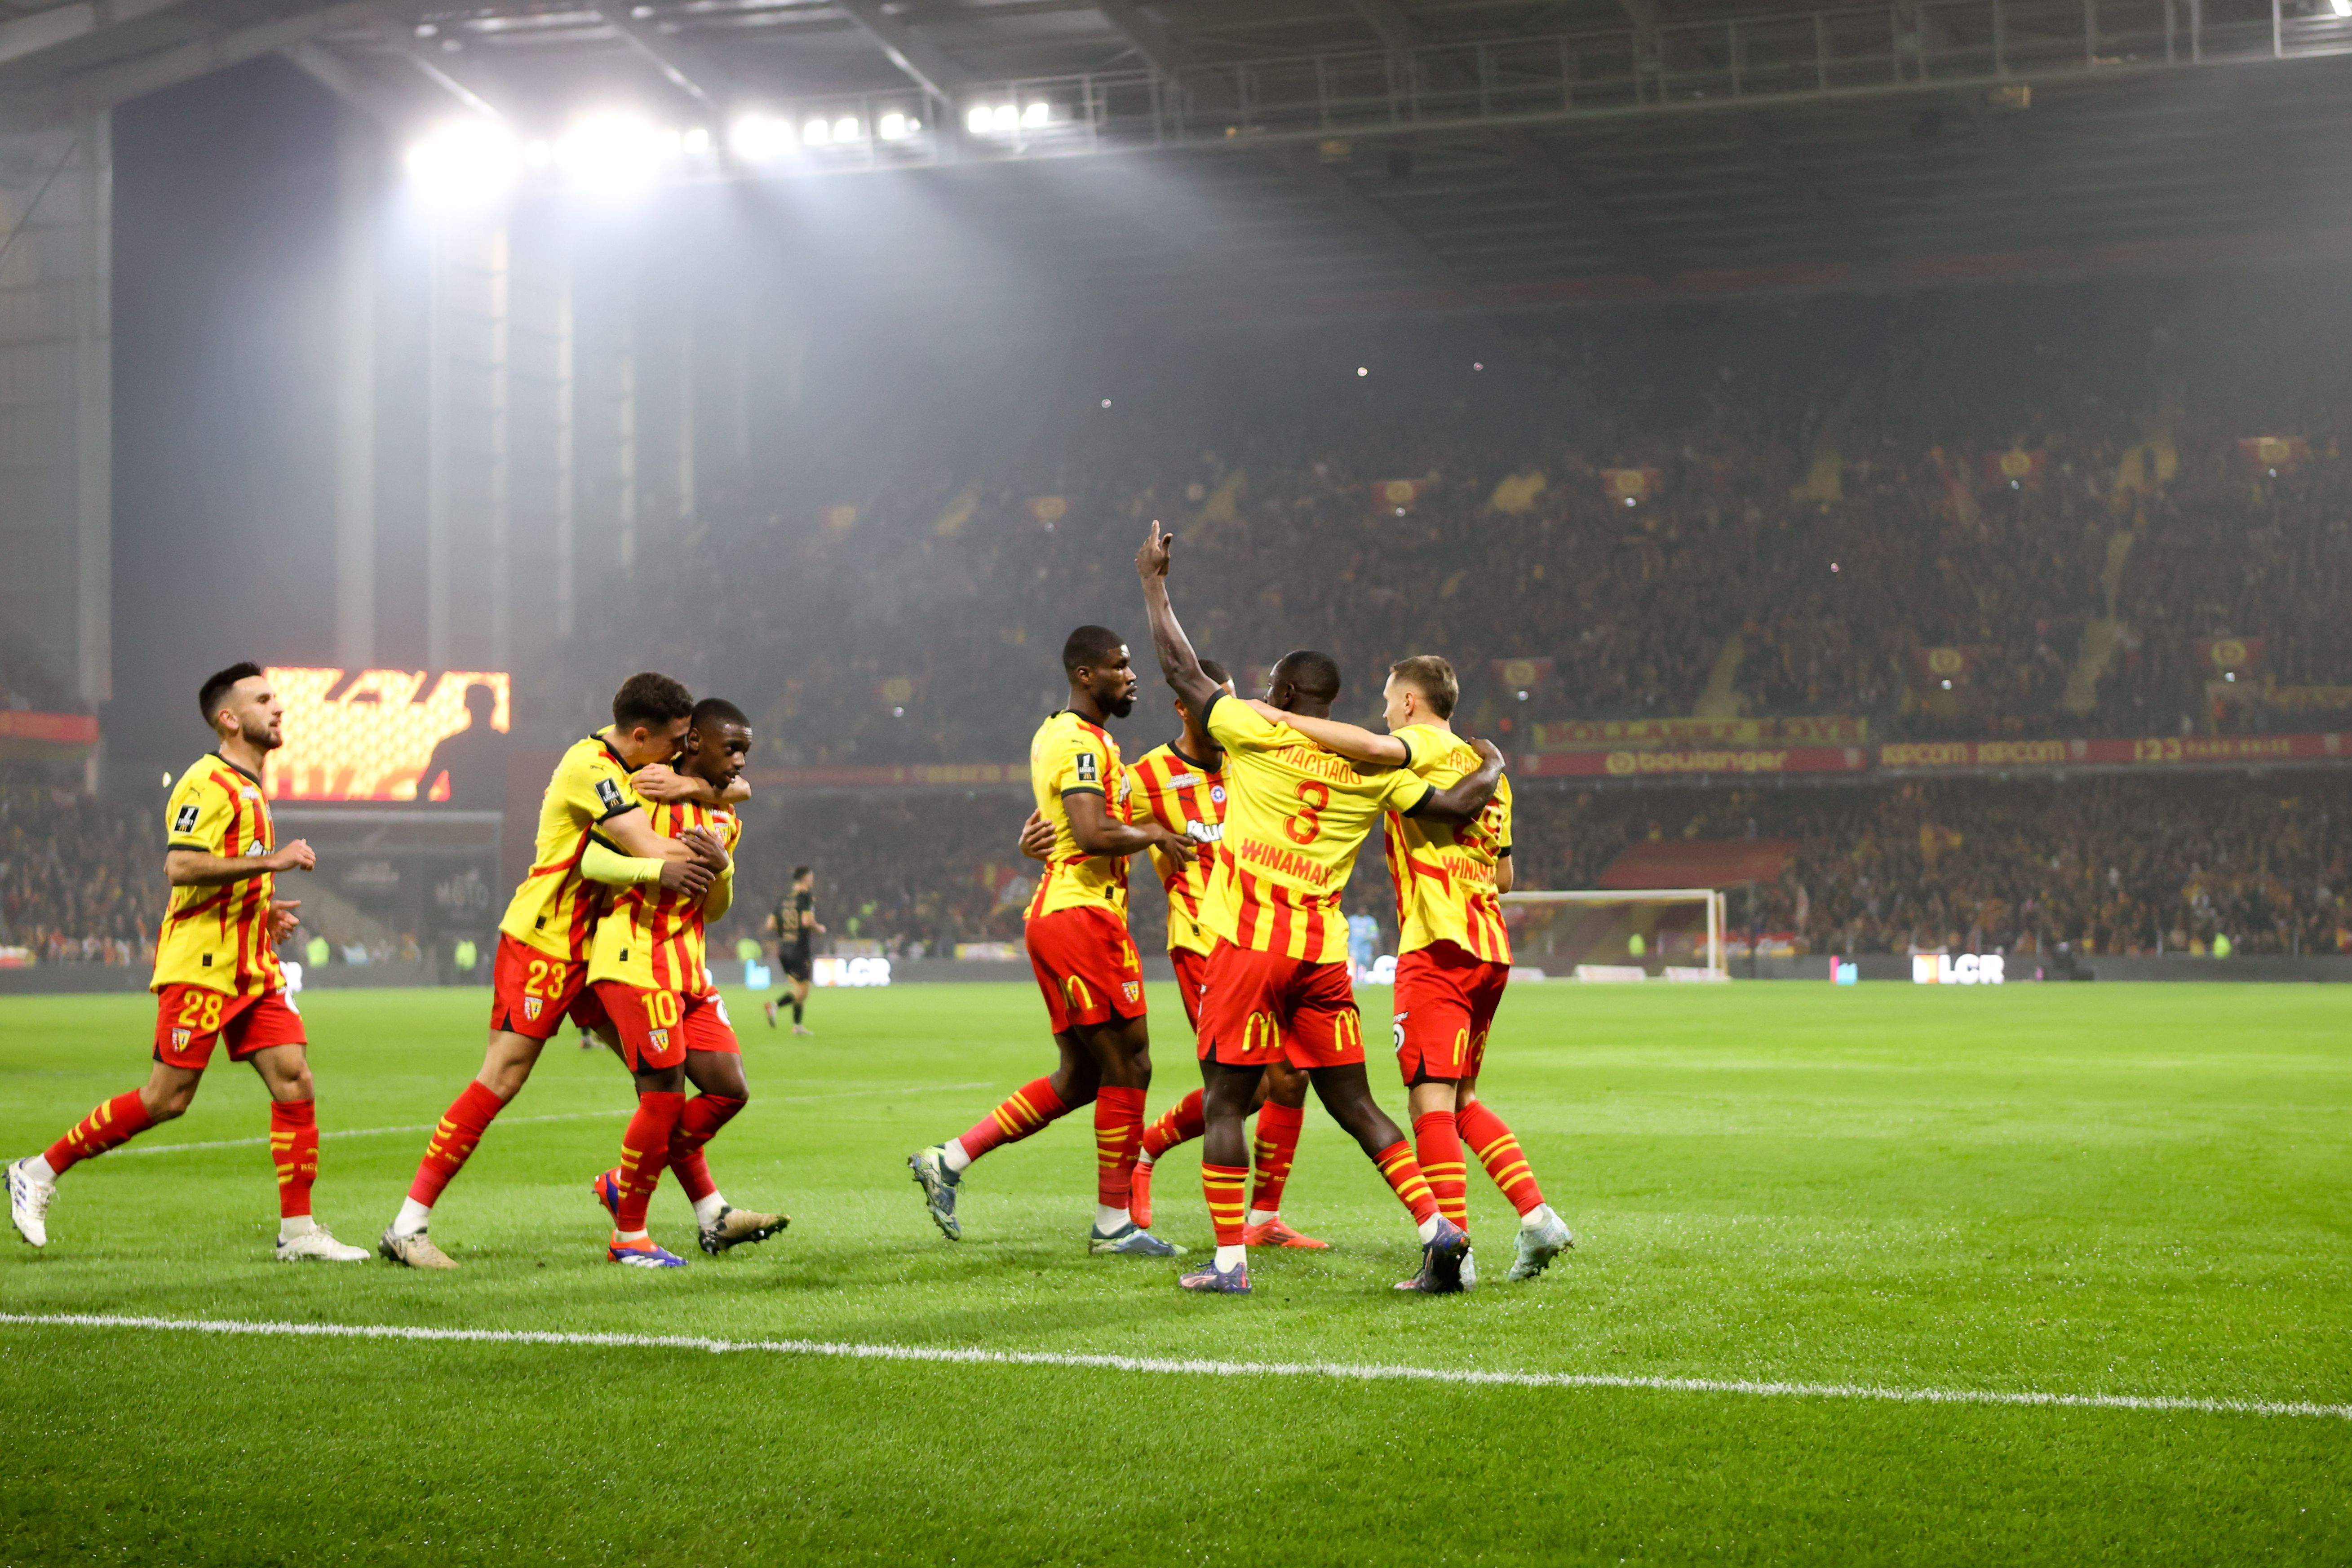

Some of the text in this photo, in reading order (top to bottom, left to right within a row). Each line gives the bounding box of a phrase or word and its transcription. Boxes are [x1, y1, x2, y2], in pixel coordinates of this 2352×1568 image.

[1170, 772, 1193, 781] GROUPE
[1276, 744, 1362, 784] MACHADO
[1638, 751, 1789, 772] boulanger
[1166, 776, 1201, 789] LEMPEREUR
[1283, 779, 1329, 845] 3
[1241, 837, 1333, 889] WINAMAX
[1122, 939, 1139, 973] 4
[525, 959, 567, 1000] 23
[178, 989, 223, 1031] 28
[642, 990, 678, 1029] 10
